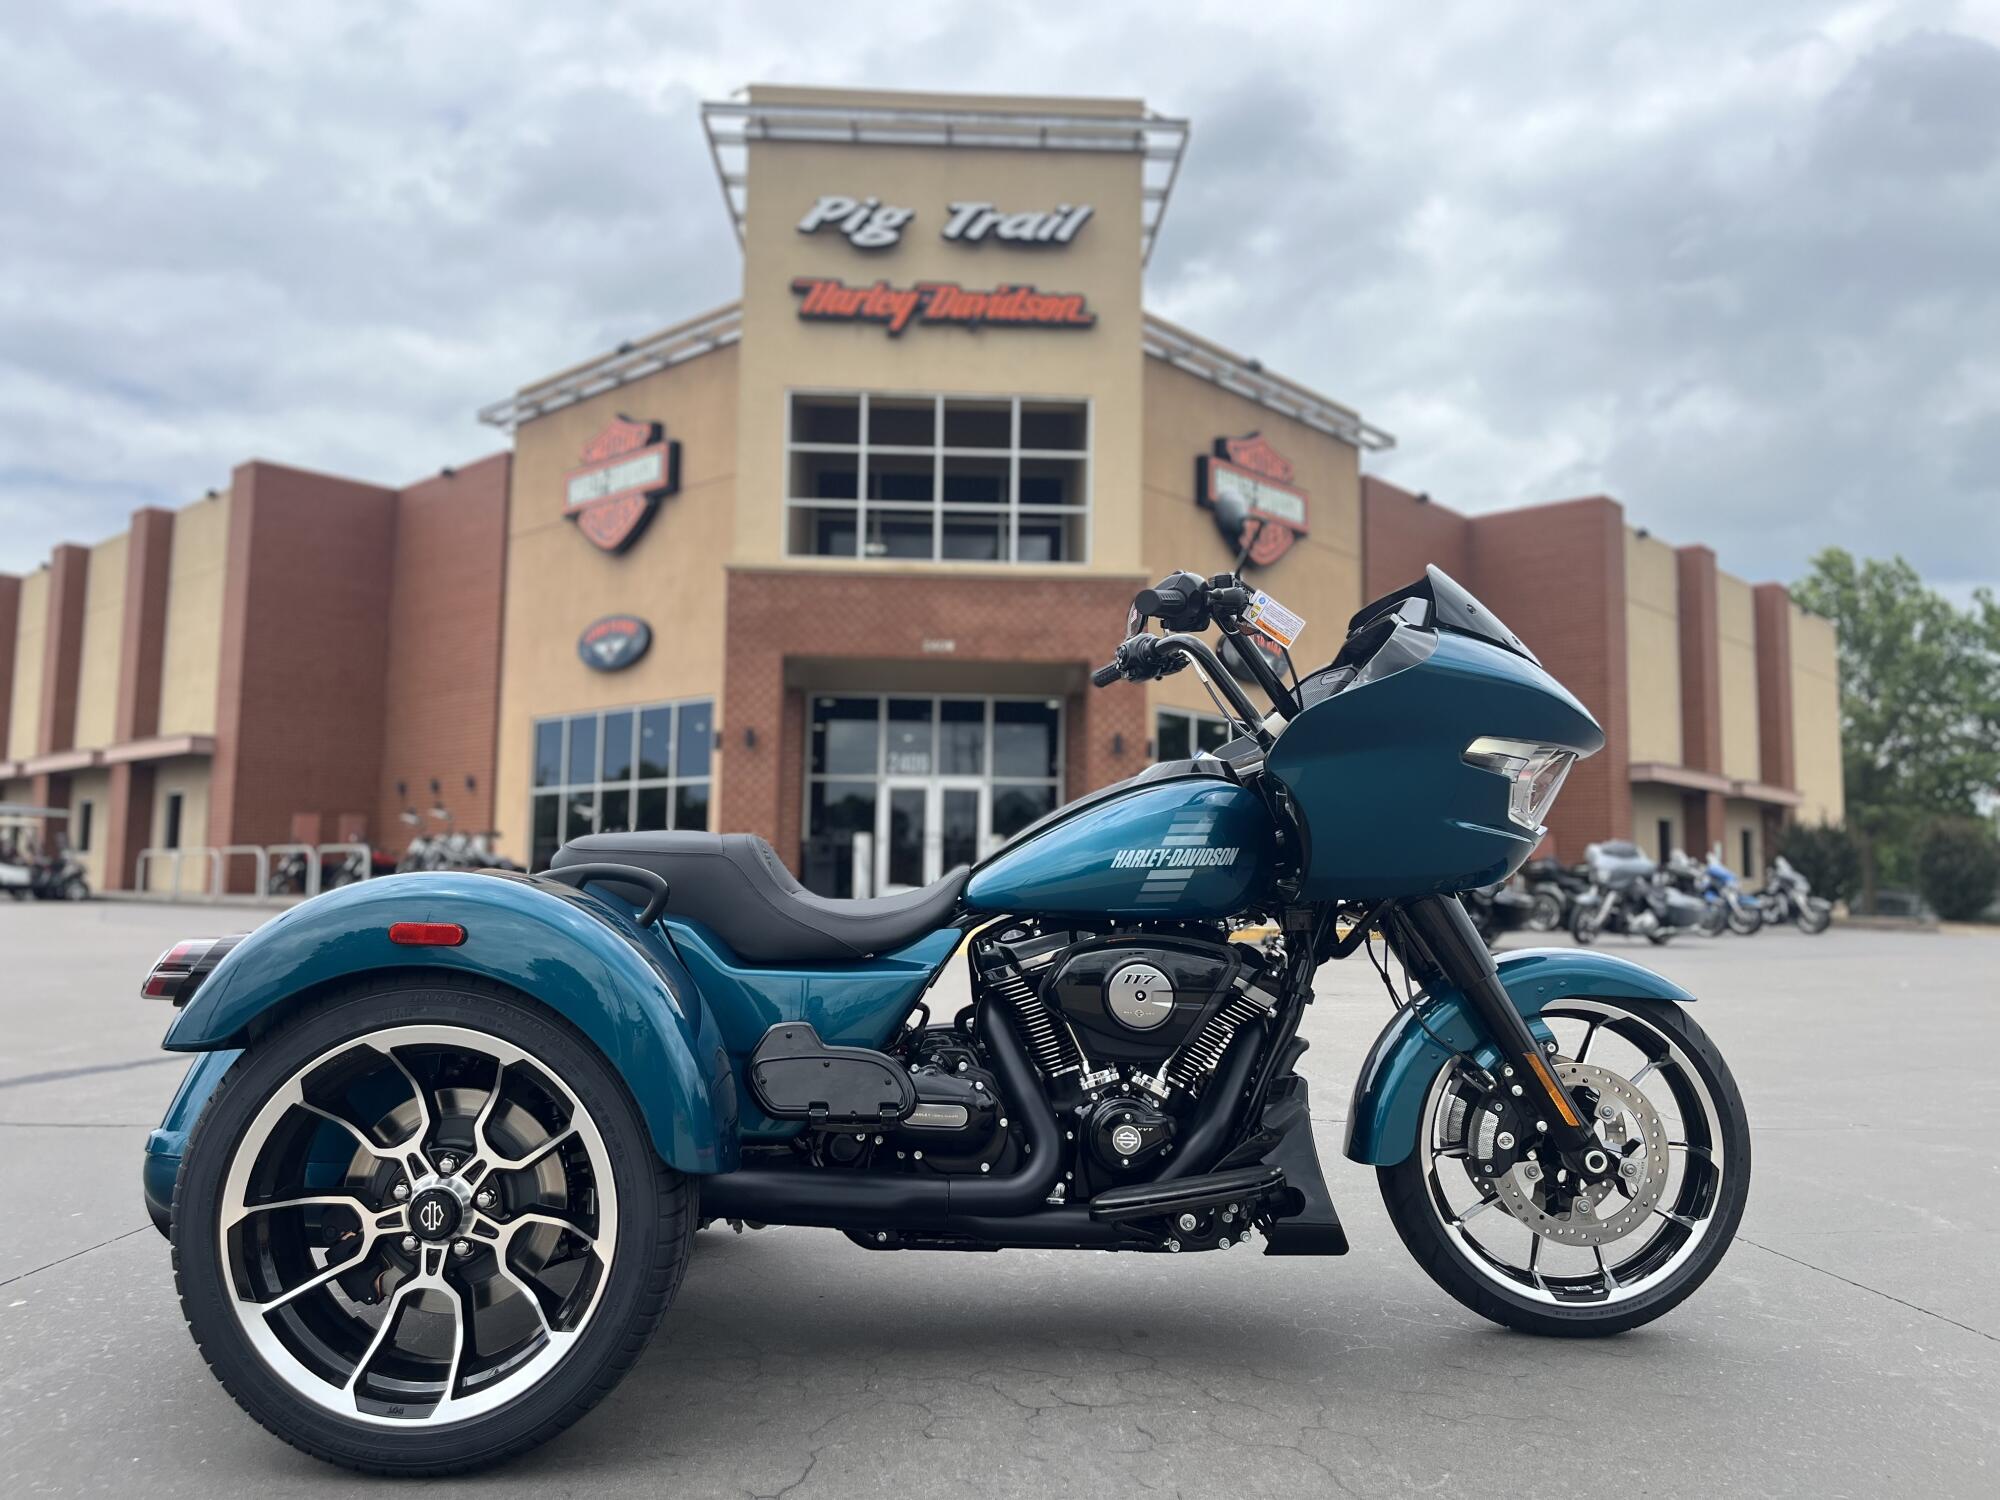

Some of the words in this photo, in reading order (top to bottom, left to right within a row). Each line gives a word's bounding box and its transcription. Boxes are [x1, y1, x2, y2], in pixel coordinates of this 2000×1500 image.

[798, 195, 915, 248] Pig
[943, 200, 1094, 243] Trail
[791, 276, 1097, 338] Harley-Davidson
[1110, 847, 1240, 869] HARLEY-DAVIDSON
[1123, 974, 1158, 985] 117
